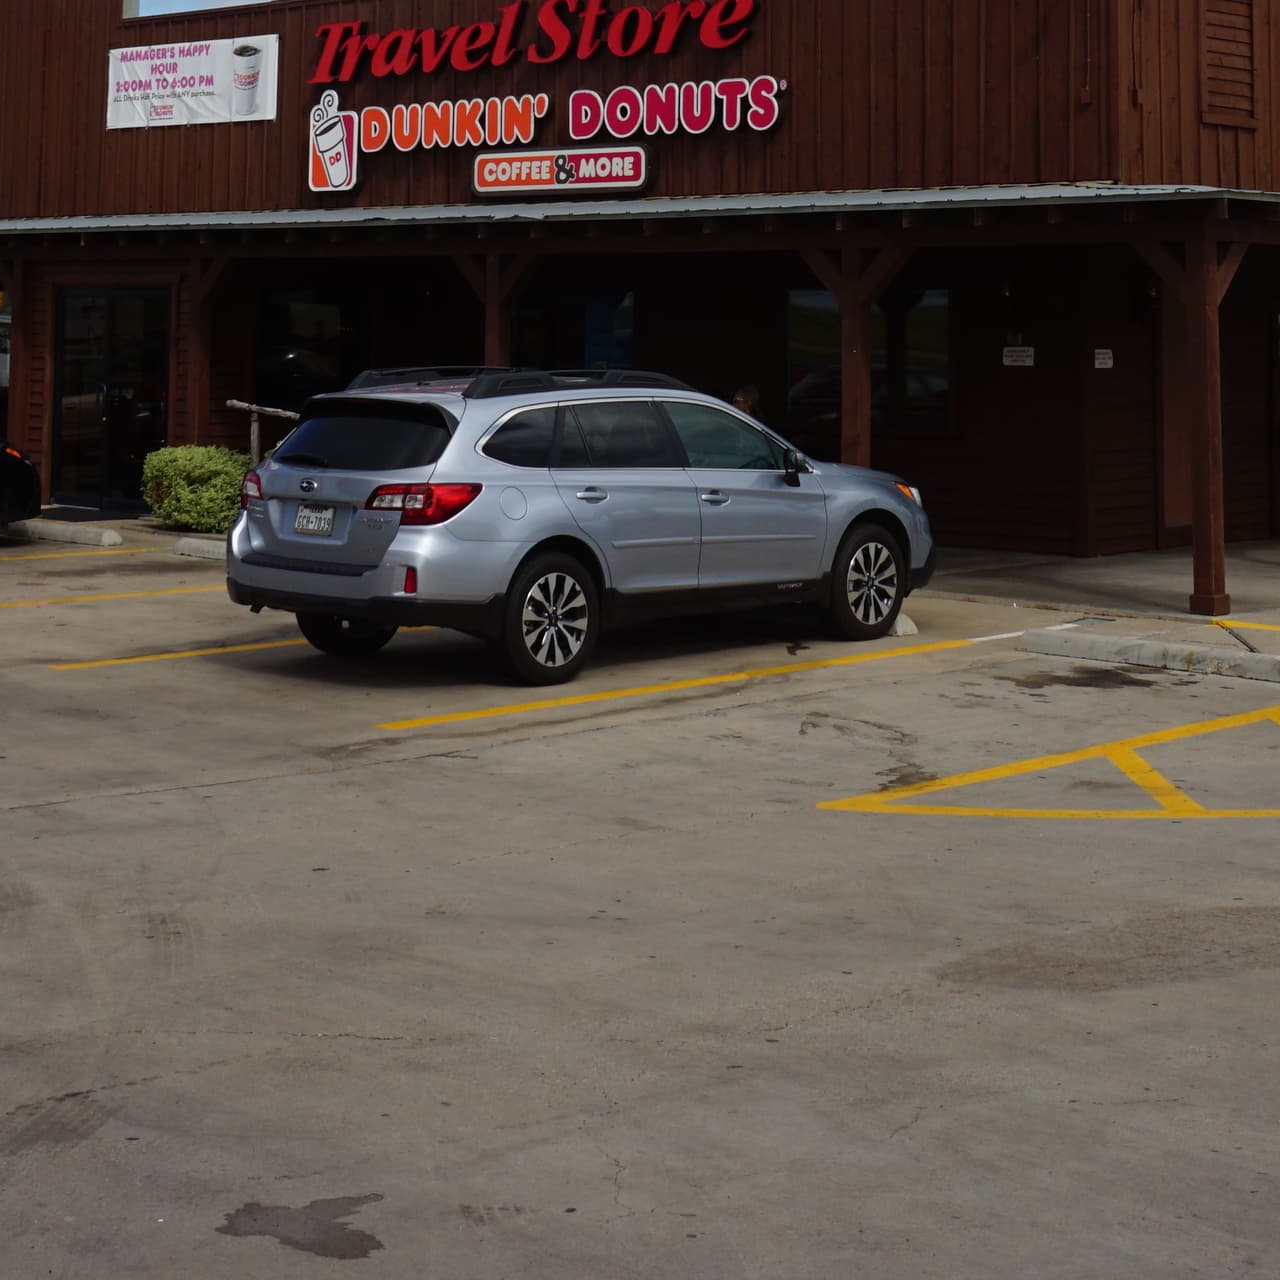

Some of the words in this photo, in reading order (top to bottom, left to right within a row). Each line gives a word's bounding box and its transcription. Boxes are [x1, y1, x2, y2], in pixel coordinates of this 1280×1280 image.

[120, 46, 176, 62] MANAGER'S
[178, 43, 211, 58] HAPPY
[150, 62, 178, 75] HOUR
[155, 77, 169, 90] TO
[170, 75, 196, 89] 6:00
[198, 74, 214, 87] PM
[360, 93, 550, 153] DUNKIN'
[569, 75, 780, 141] DONUTS
[328, 150, 343, 167] DD
[483, 160, 551, 183] COFFEE
[553, 154, 576, 184] &
[578, 156, 635, 180] MORE
